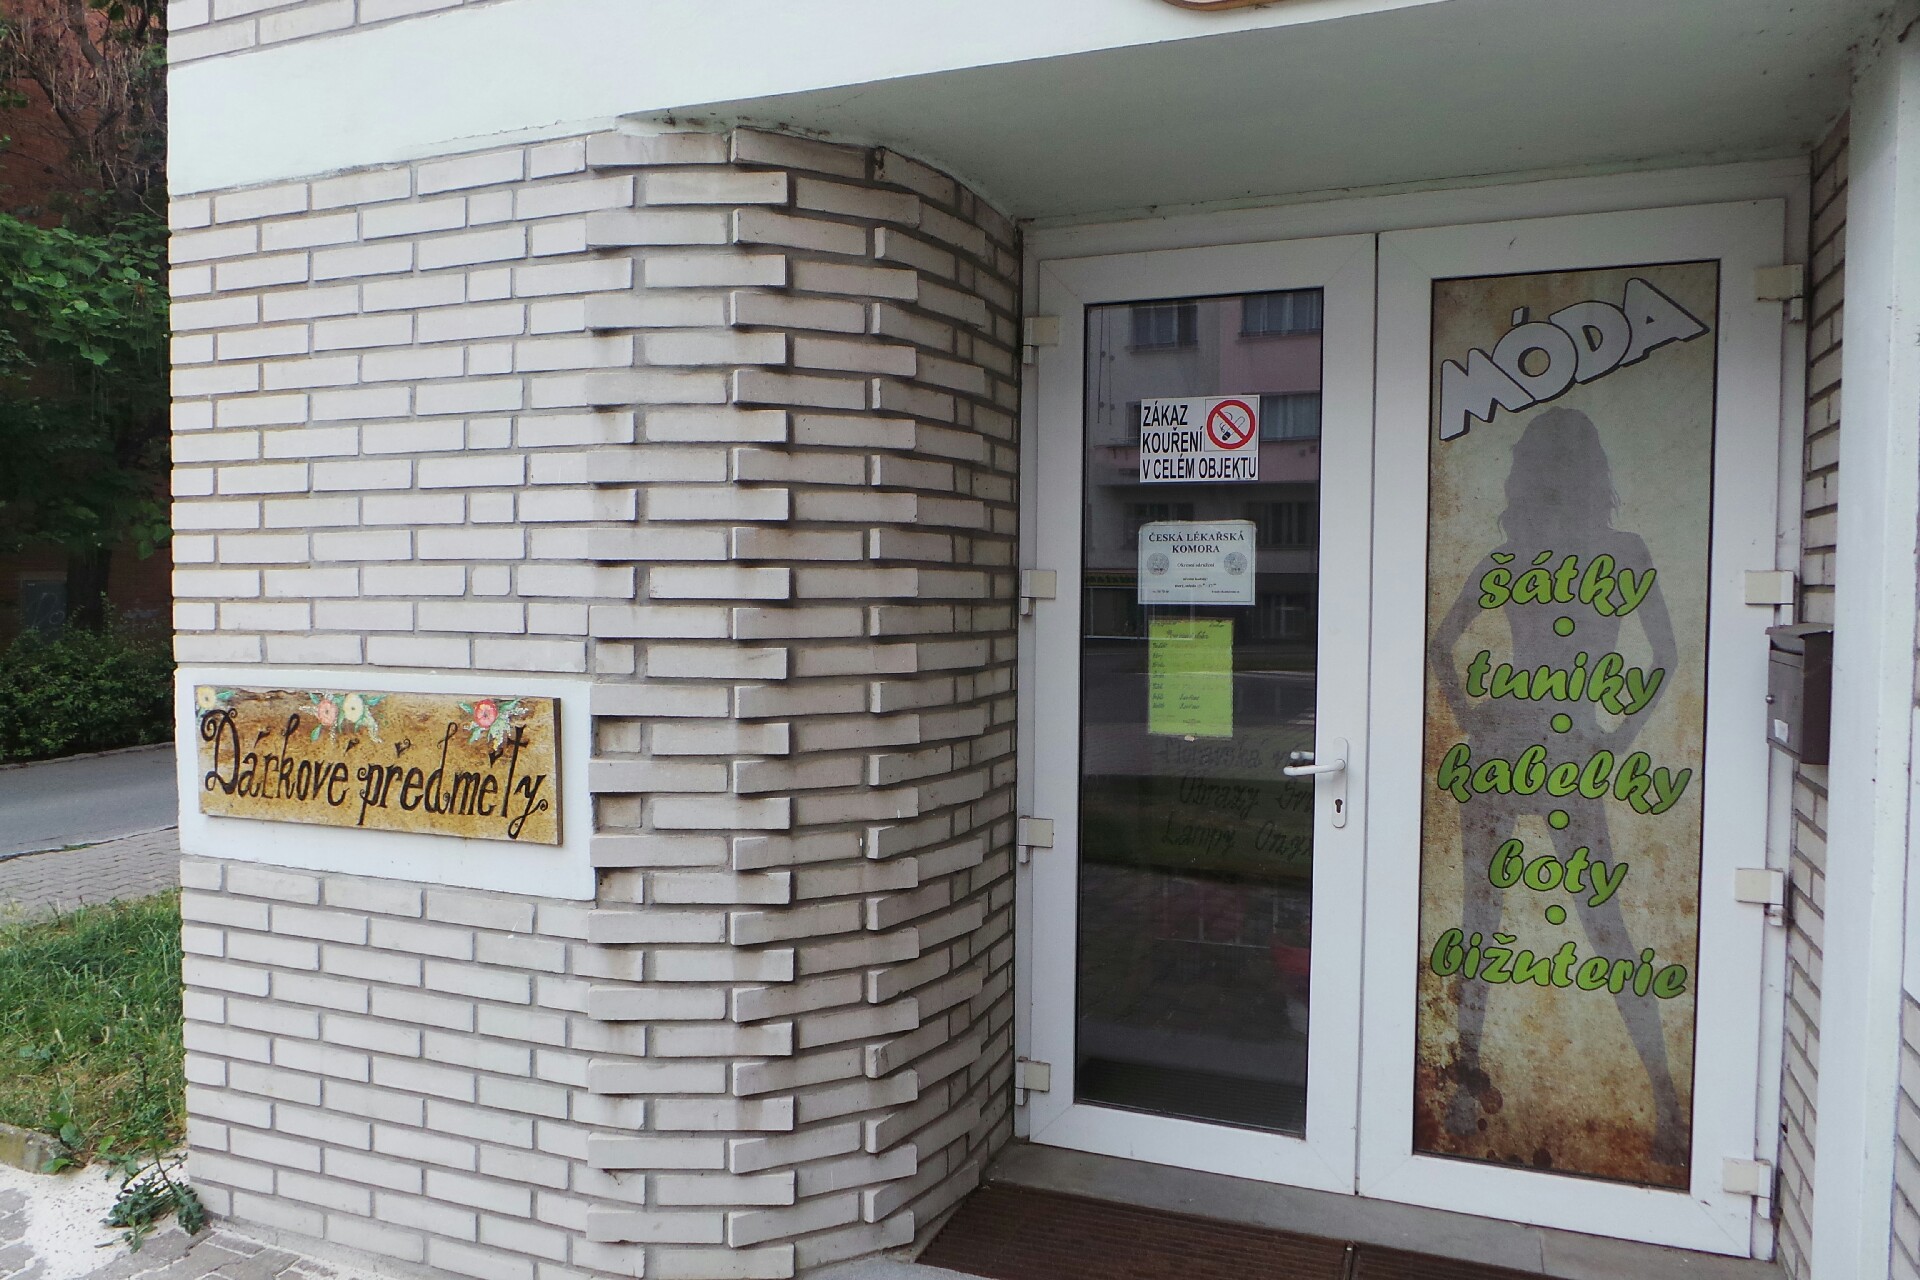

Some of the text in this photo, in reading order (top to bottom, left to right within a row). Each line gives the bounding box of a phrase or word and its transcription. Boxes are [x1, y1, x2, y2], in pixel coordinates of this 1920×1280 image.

[1439, 277, 1711, 442] MÓDA
[1142, 426, 1203, 453] KOUŘENÍ
[1143, 401, 1188, 427] ZÁKAZ
[1143, 453, 1256, 480] V CELÉM OBJEKTU
[1148, 530, 1245, 542] ČESKÁ LÉKAŘSKÁ
[1172, 544, 1220, 554] KOMORA
[1478, 550, 1657, 617] šátky
[1466, 649, 1665, 715] tuniky
[200, 708, 549, 840] Dárkové předměty
[1437, 743, 1692, 815] kabelky
[1488, 838, 1629, 907] boty
[1430, 928, 1688, 999] bižuterie
